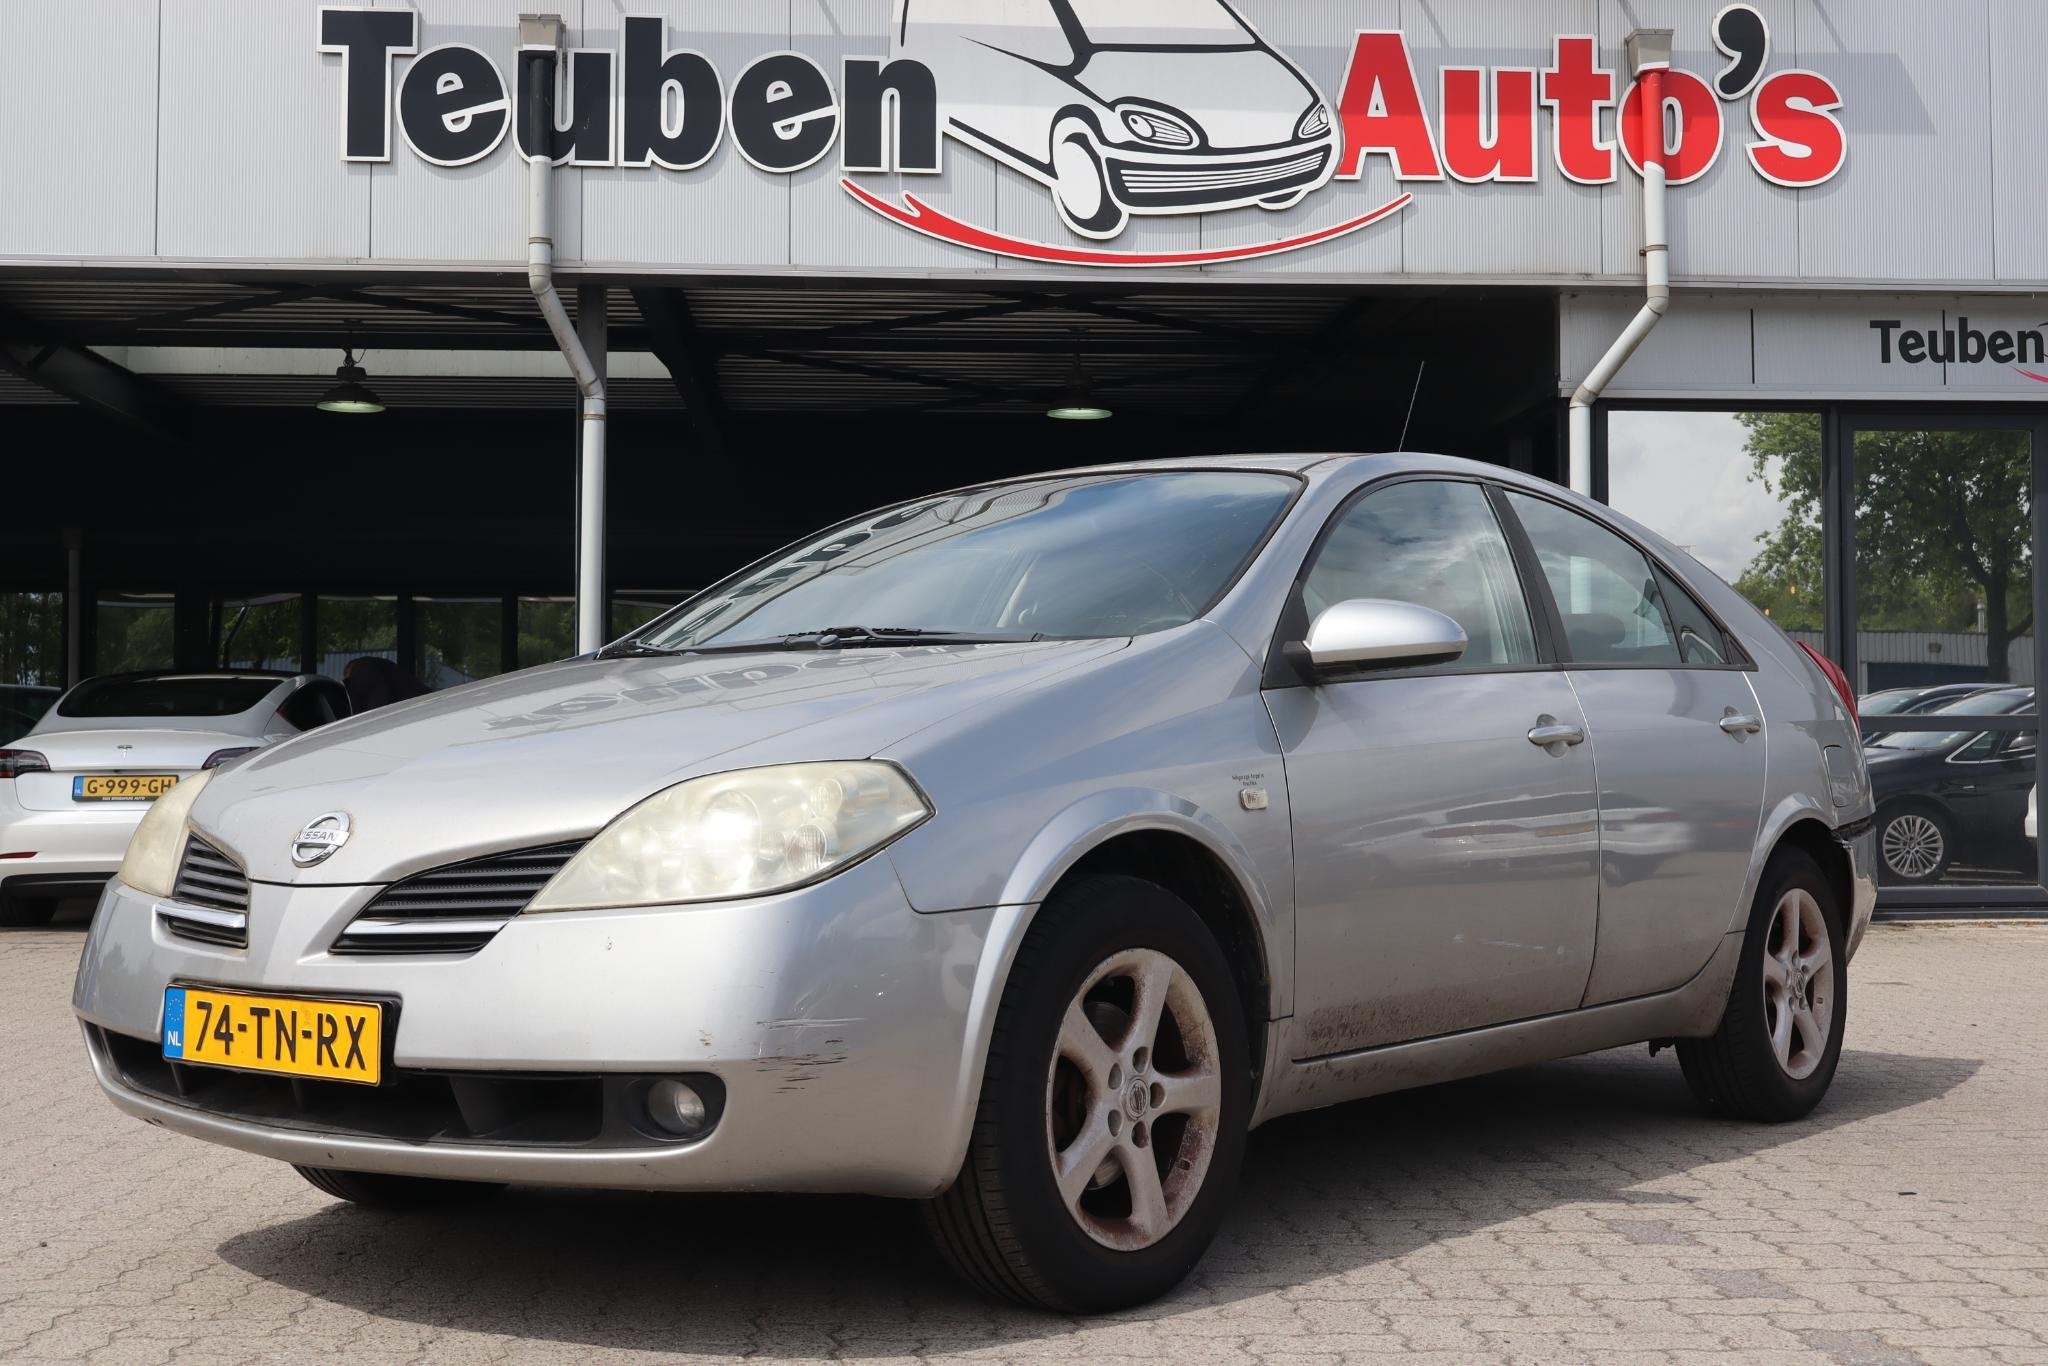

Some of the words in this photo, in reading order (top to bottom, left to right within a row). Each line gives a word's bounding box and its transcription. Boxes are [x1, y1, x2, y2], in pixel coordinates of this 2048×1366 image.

[318, 6, 943, 174] Teuben
[1335, 3, 1847, 187] Auto's
[1869, 316, 2045, 364] Teuben
[87, 779, 172, 794] G-999-GH
[167, 1030, 182, 1047] NL
[195, 1000, 367, 1071] 74-TN-RX
